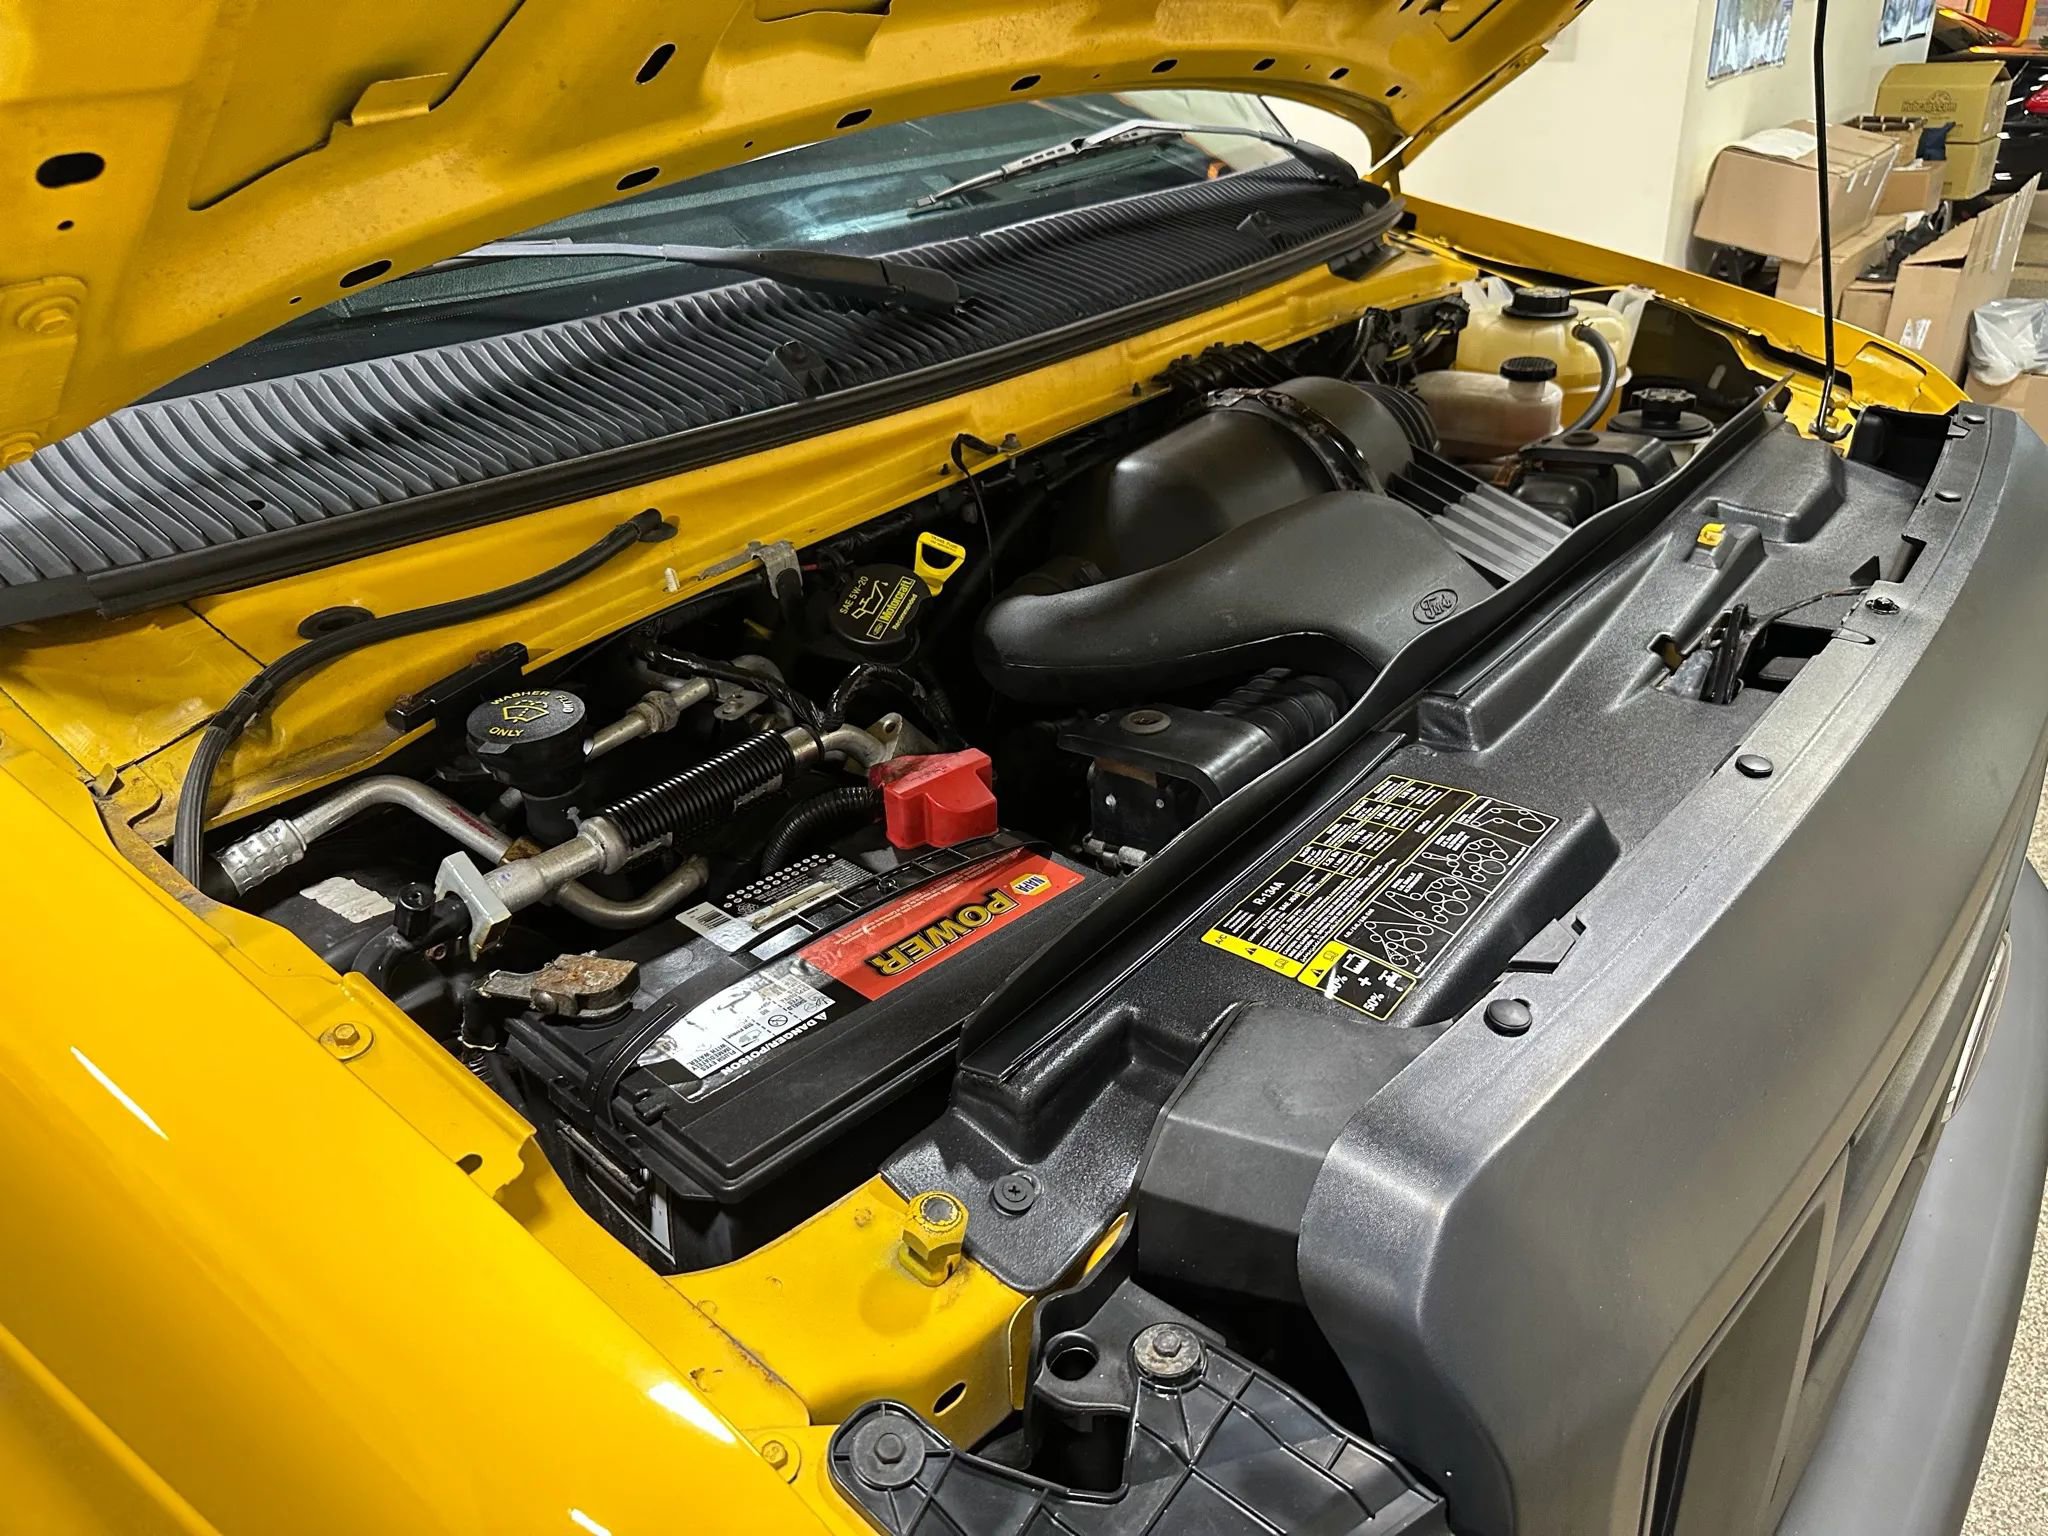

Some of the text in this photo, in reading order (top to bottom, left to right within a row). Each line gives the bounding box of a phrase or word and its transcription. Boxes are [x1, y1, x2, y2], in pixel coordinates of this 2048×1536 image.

[840, 576, 869, 614] SAE 5W-20
[879, 579, 913, 622] Motorcraft
[892, 593, 918, 630] Recommended
[1420, 594, 1453, 620] Ford
[490, 690, 575, 714] WASHER FLUID
[488, 727, 525, 737] ONLY
[1015, 875, 1046, 894] NAPA
[1253, 882, 1285, 905] R-134A
[1278, 901, 1291, 910] SAE
[864, 888, 1019, 976] POWER
[1215, 934, 1228, 944] A/C
[787, 995, 802, 1006] EYES
[1363, 992, 1384, 1011] 50%
[691, 1046, 732, 1071] IMMEDIATELY
[710, 1043, 727, 1055] WITH
[719, 1019, 817, 1076] DANGER/POISON
[700, 1049, 737, 1072] FLUSH EYES
